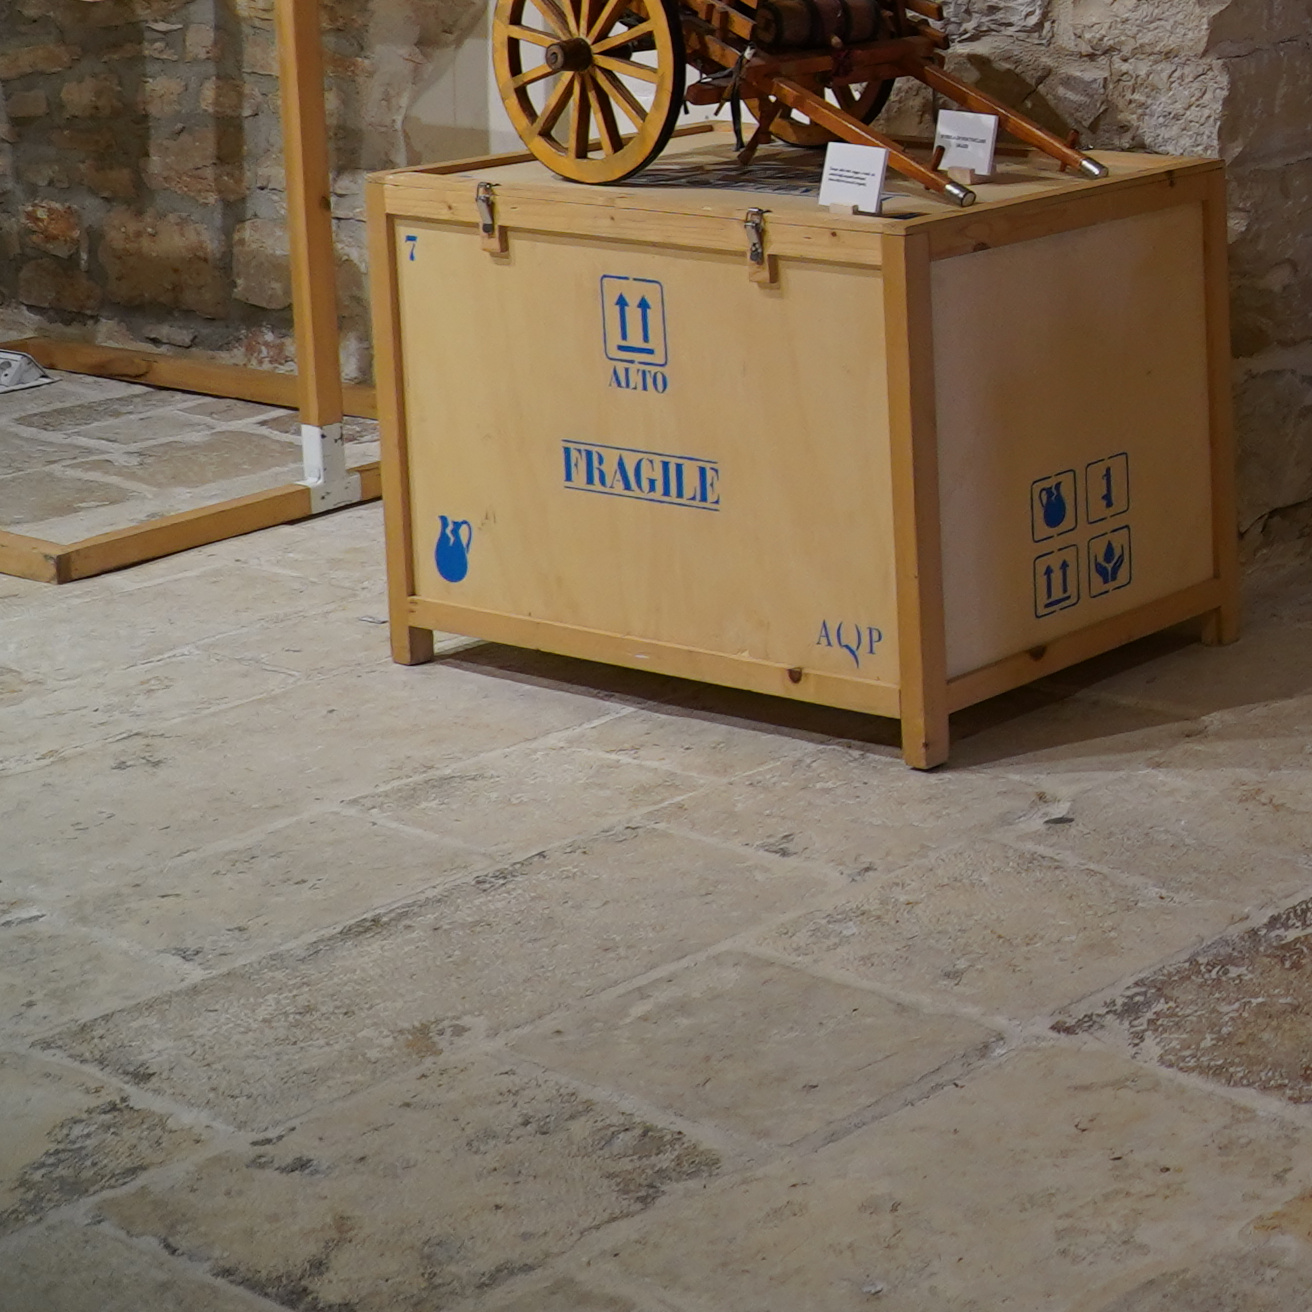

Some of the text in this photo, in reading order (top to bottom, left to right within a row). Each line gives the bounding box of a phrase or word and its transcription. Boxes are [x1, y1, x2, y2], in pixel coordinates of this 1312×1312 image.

[404, 235, 418, 262] 7
[608, 366, 669, 394] ALTO
[562, 446, 720, 505] FRAGILE
[816, 619, 883, 668] AQP
